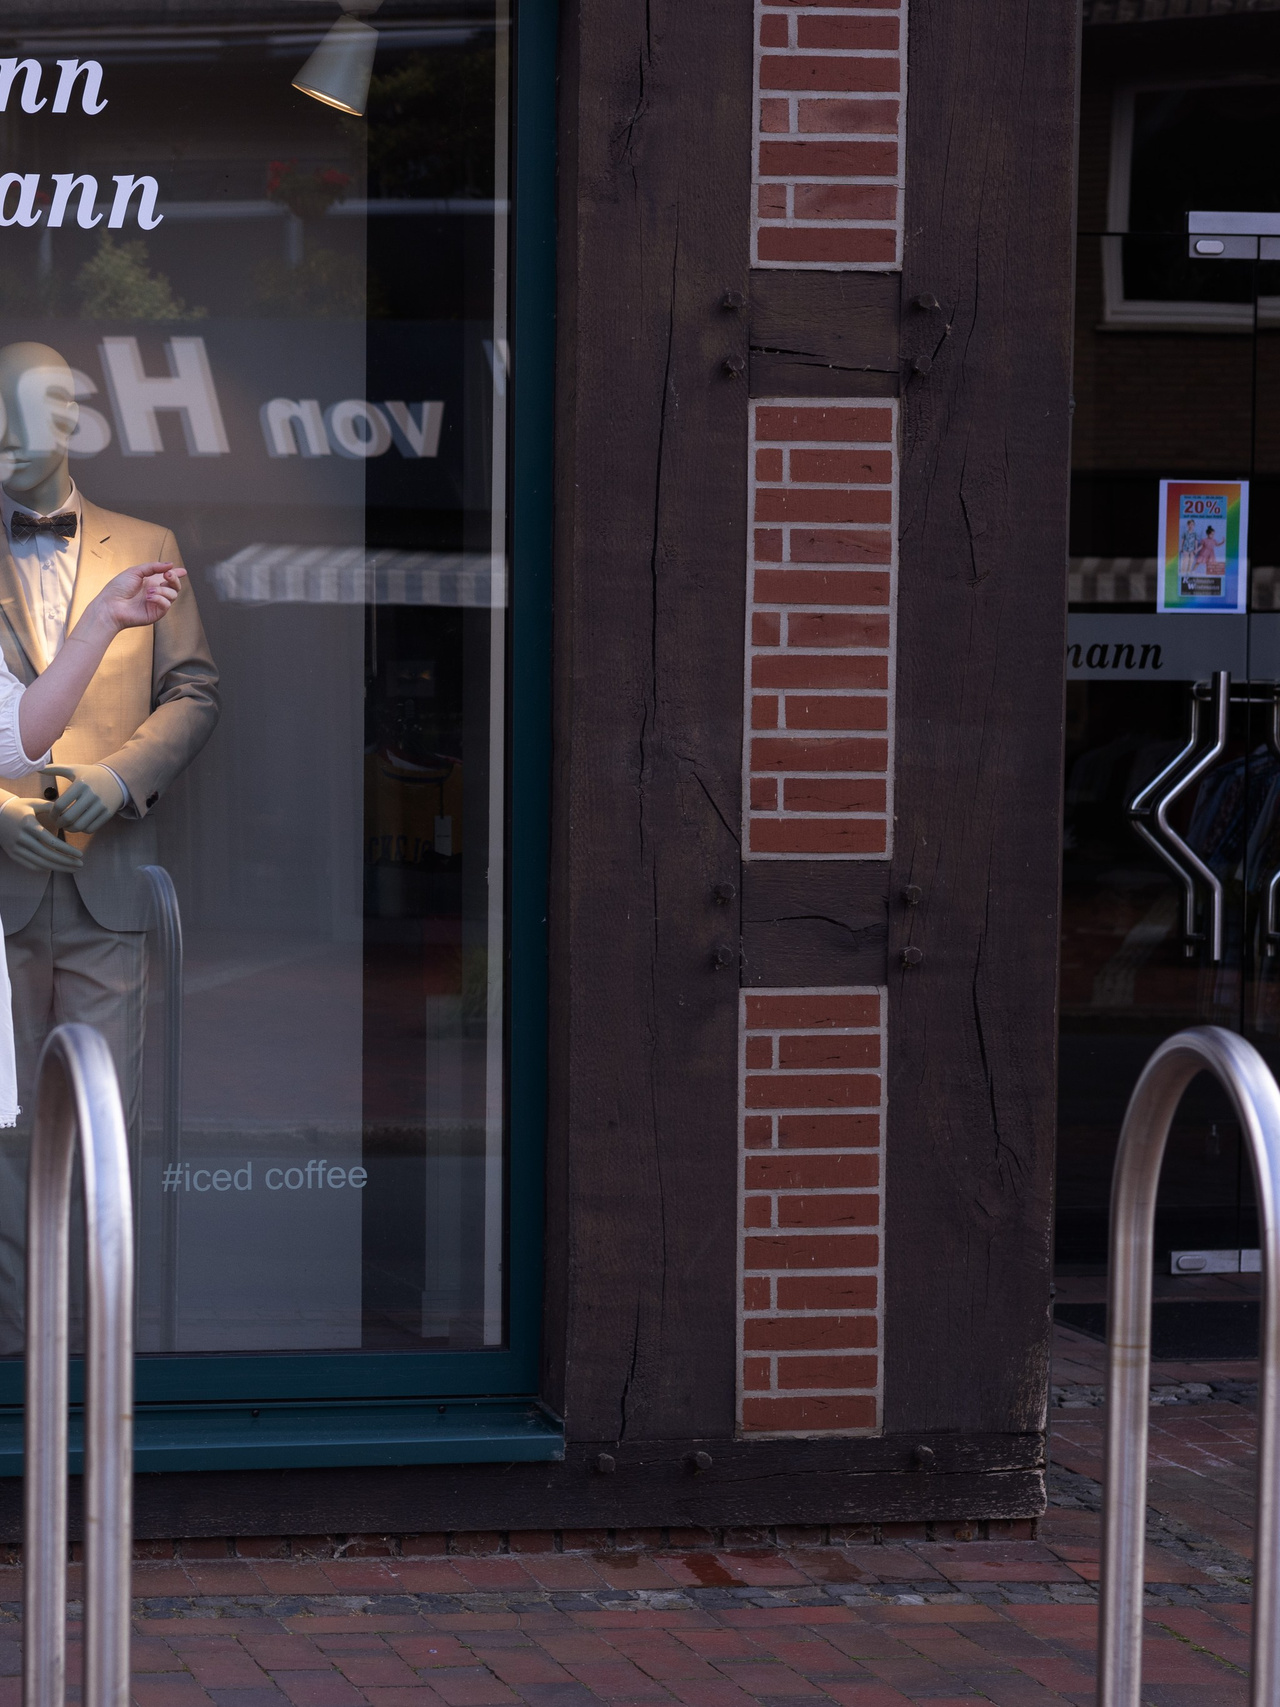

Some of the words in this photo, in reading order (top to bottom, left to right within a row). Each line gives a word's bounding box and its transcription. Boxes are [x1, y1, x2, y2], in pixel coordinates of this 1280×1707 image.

[1184, 500, 1221, 515] 20%
[162, 1161, 253, 1192] #iced
[265, 1159, 369, 1190] coffee
